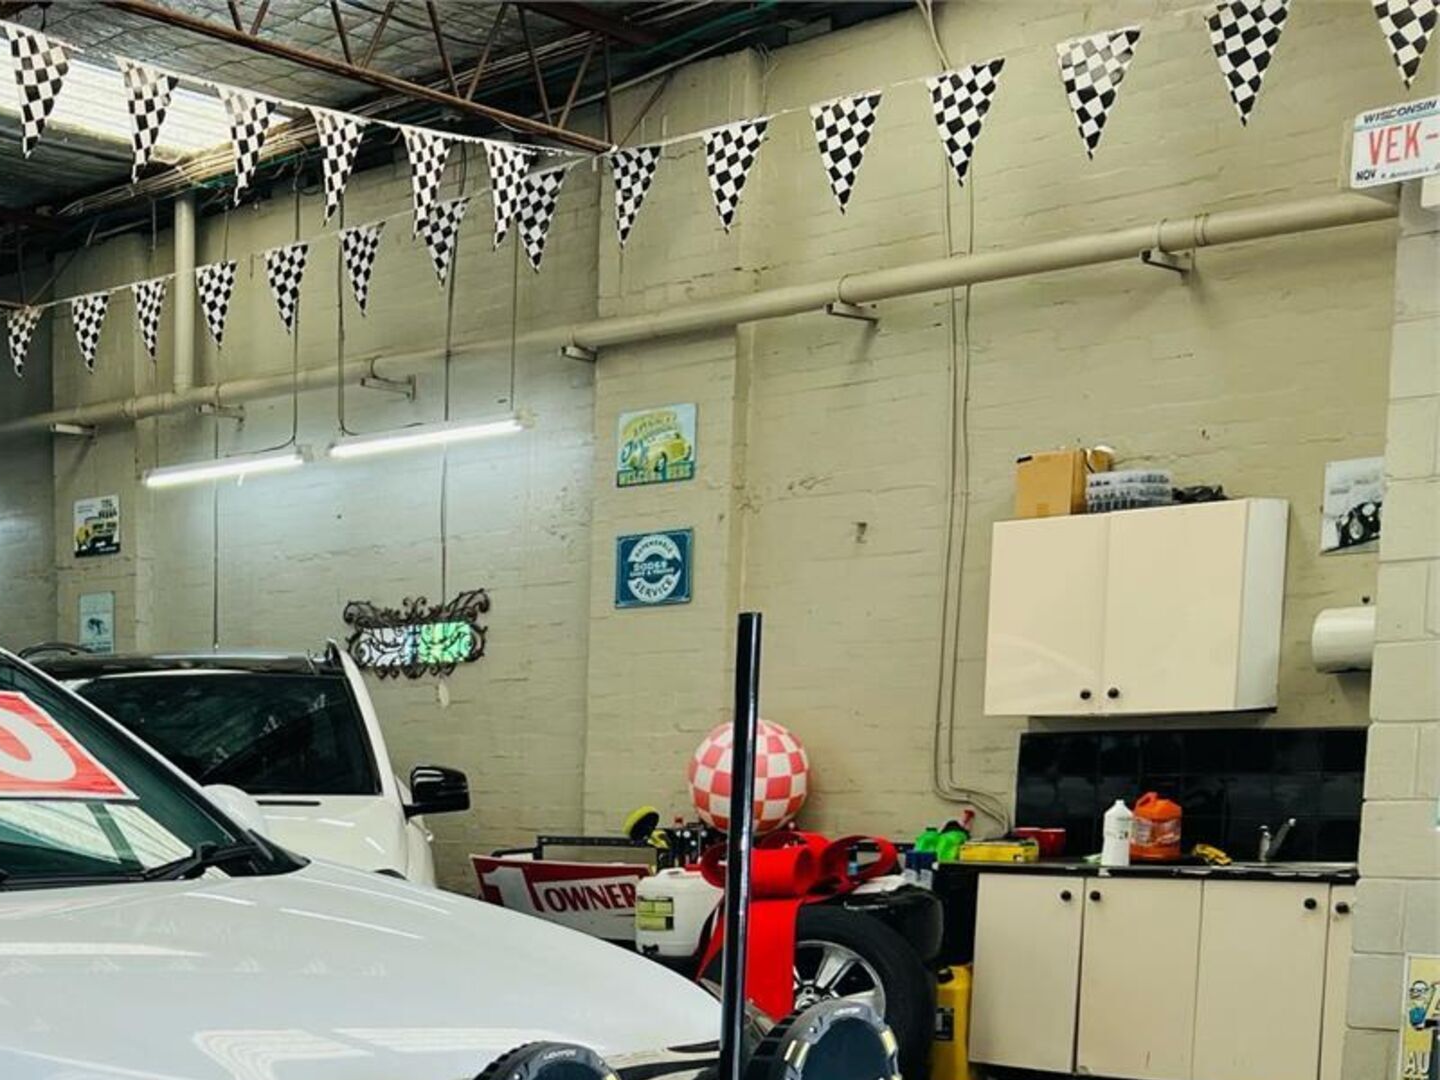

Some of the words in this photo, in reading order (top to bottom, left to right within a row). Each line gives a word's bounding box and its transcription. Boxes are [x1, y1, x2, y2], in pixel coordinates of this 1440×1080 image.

[1363, 100, 1437, 124] WISCONSIN
[1355, 169, 1376, 181] NOV
[634, 580, 673, 598] SERVICE
[544, 883, 637, 913] OWNER
